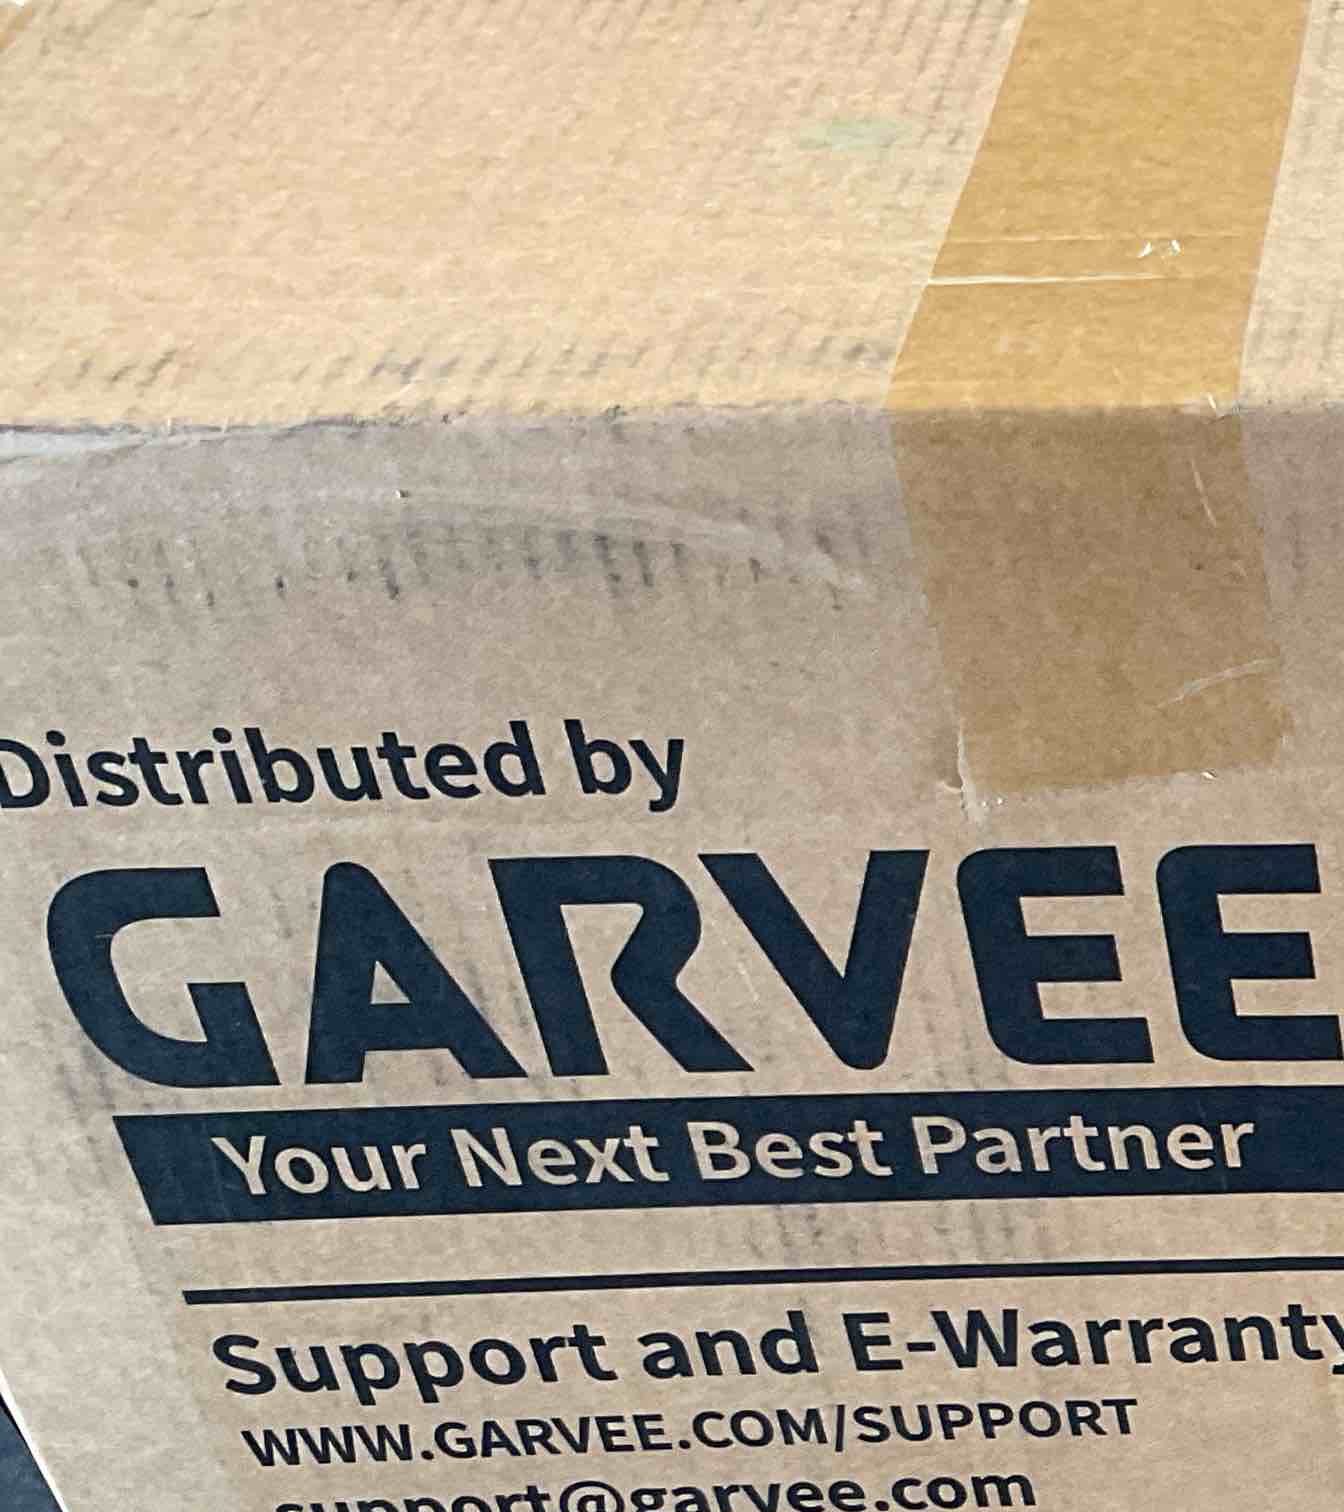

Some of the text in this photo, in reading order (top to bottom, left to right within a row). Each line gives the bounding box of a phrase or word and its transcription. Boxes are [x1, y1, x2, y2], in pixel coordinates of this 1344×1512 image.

[0, 718, 685, 813] Distributed by
[46, 843, 1344, 1089] GARVEE
[210, 1115, 1255, 1195] Your Next Best Partner
[212, 1324, 619, 1406] Support
[637, 1310, 820, 1380] and
[240, 1398, 1138, 1467] WWW.GARVEE.COM/SUPPORT
